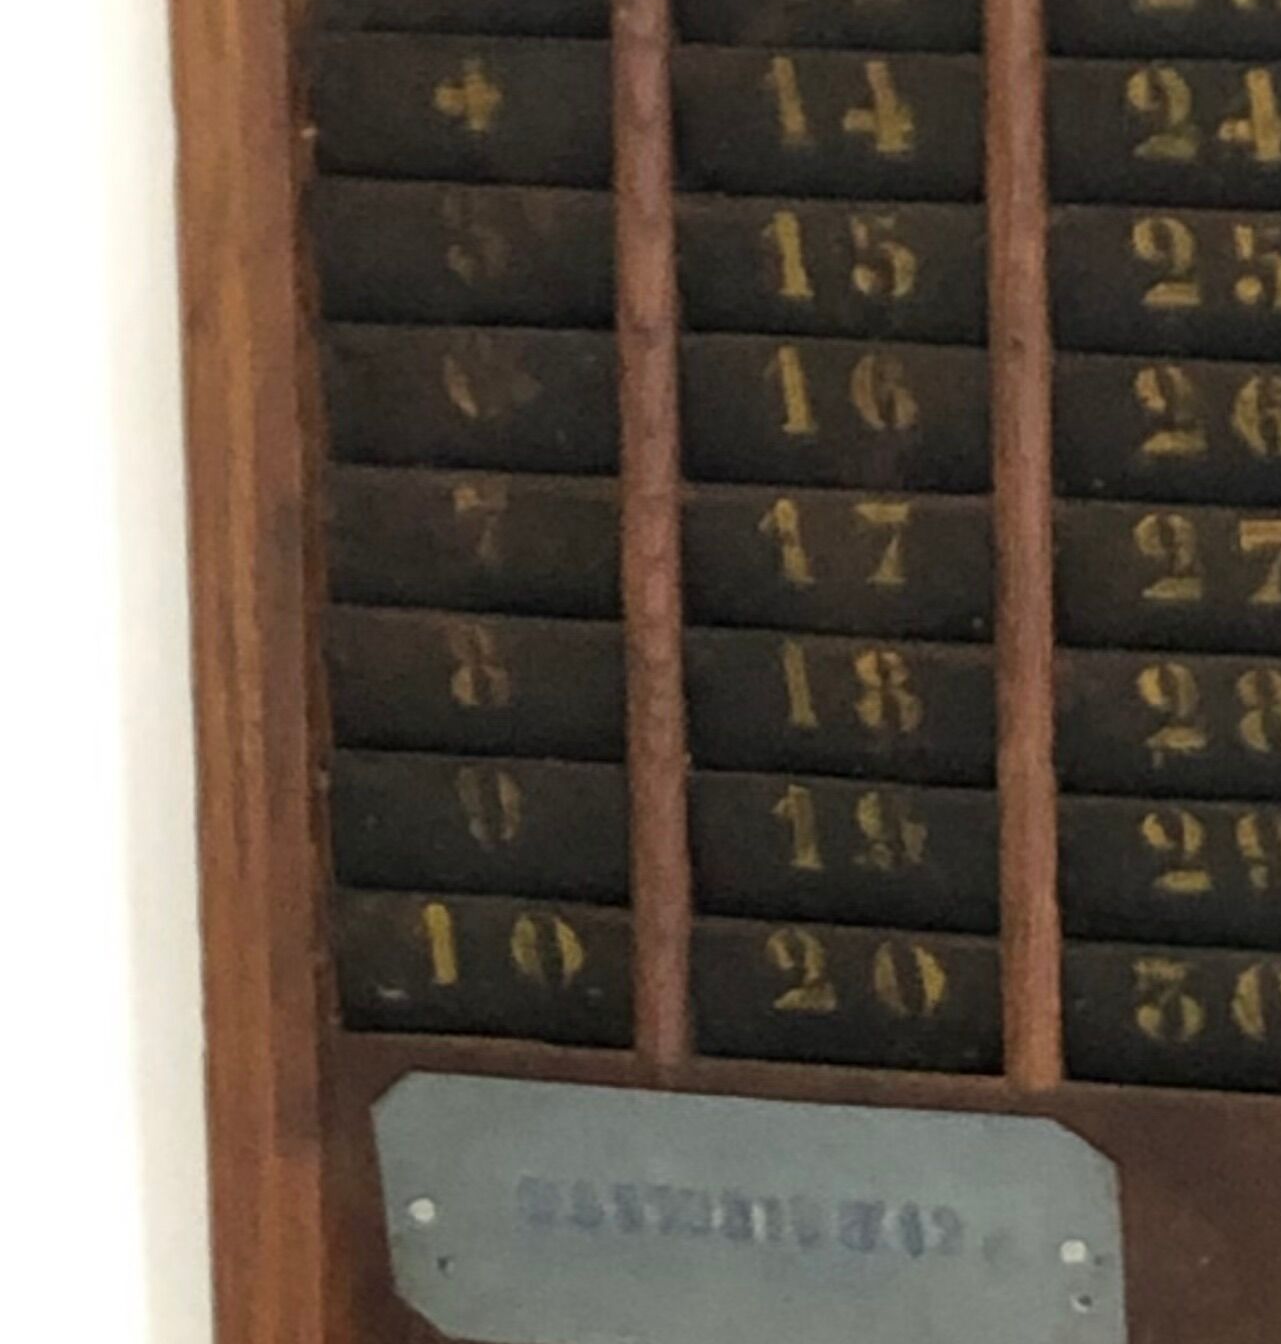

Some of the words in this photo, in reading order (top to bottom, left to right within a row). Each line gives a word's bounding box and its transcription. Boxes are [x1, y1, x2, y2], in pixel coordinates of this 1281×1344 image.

[765, 55, 916, 154] 14
[764, 210, 916, 301] 15
[765, 344, 919, 435] 16
[759, 497, 910, 588] 17
[781, 640, 924, 732] 18
[416, 903, 586, 987] 10
[765, 929, 948, 1016] 20
